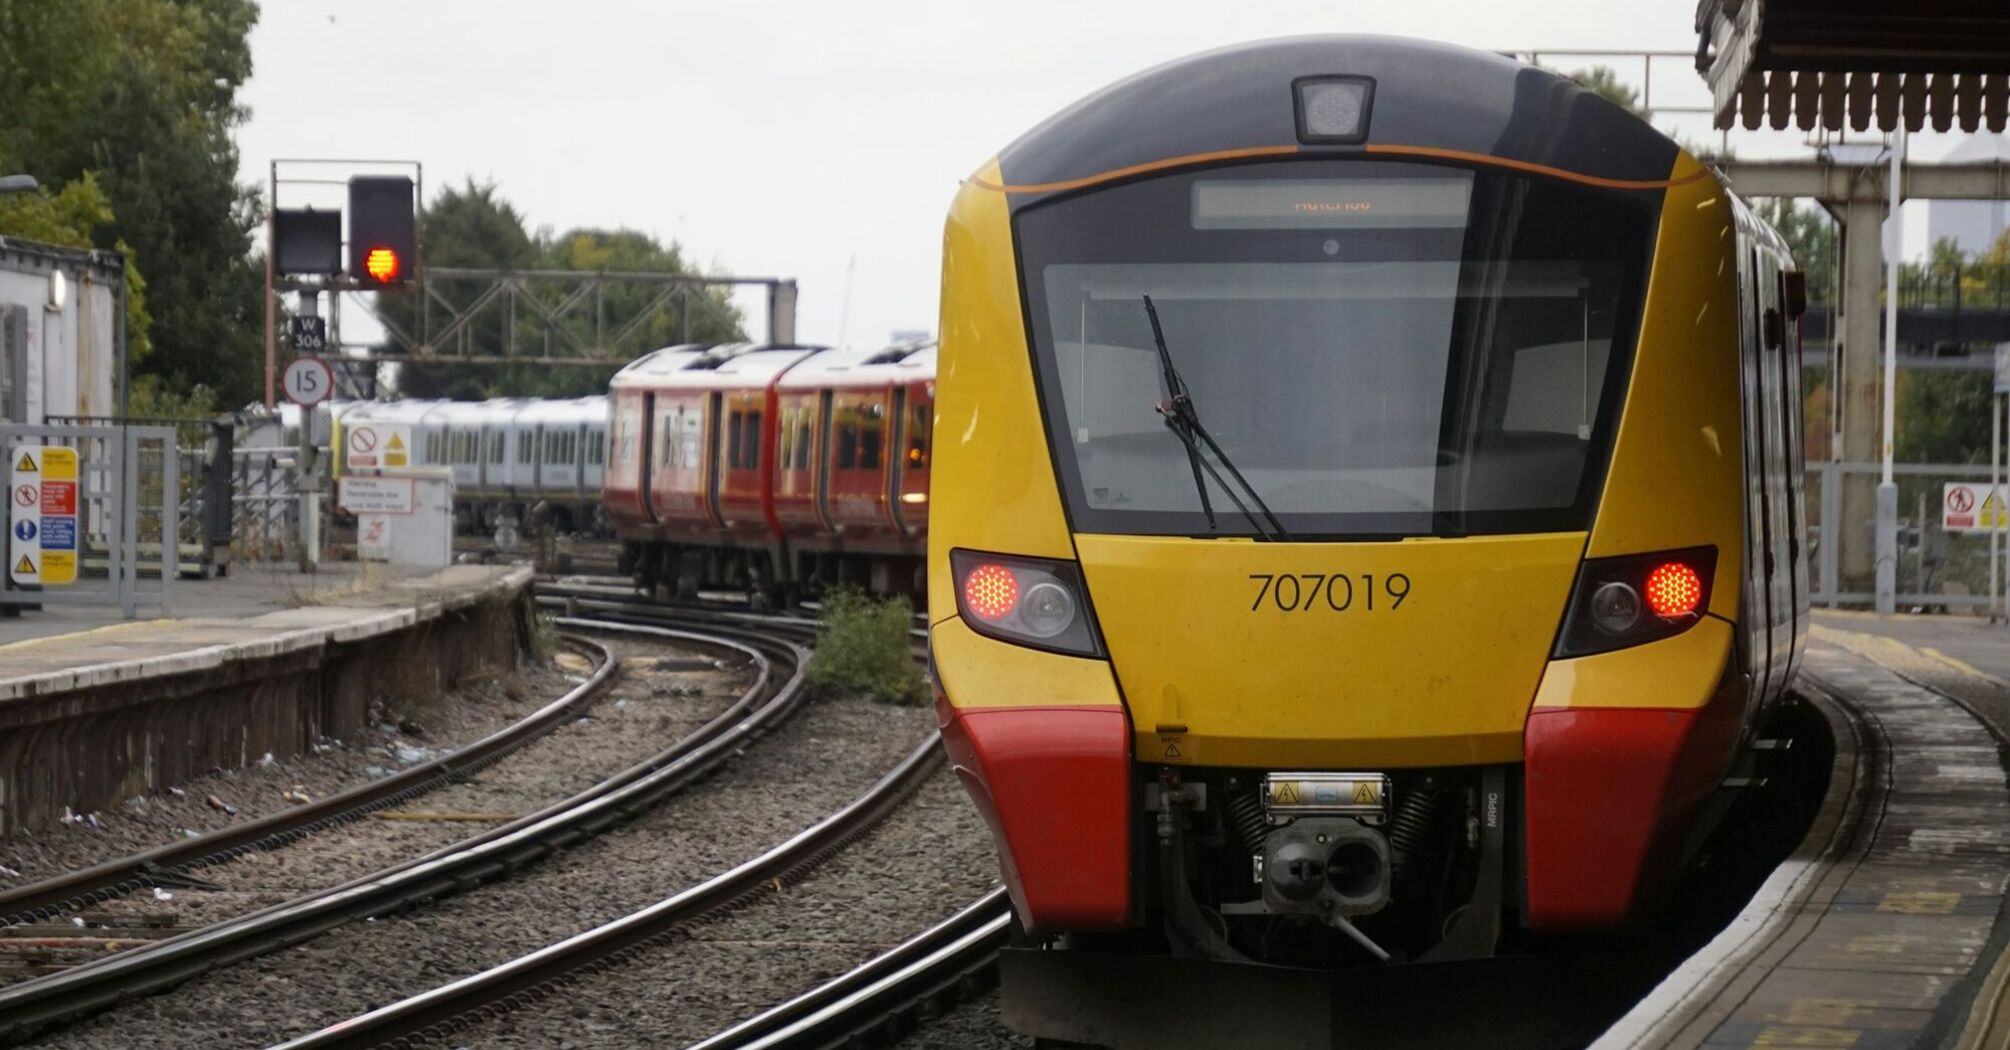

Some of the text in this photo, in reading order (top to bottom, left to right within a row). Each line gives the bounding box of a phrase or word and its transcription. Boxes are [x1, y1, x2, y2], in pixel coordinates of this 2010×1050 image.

[301, 318, 316, 330] W
[295, 335, 321, 347] 306
[296, 370, 317, 392] 15
[1248, 573, 1411, 612] 707019
[1487, 792, 1498, 828] MRPIC
